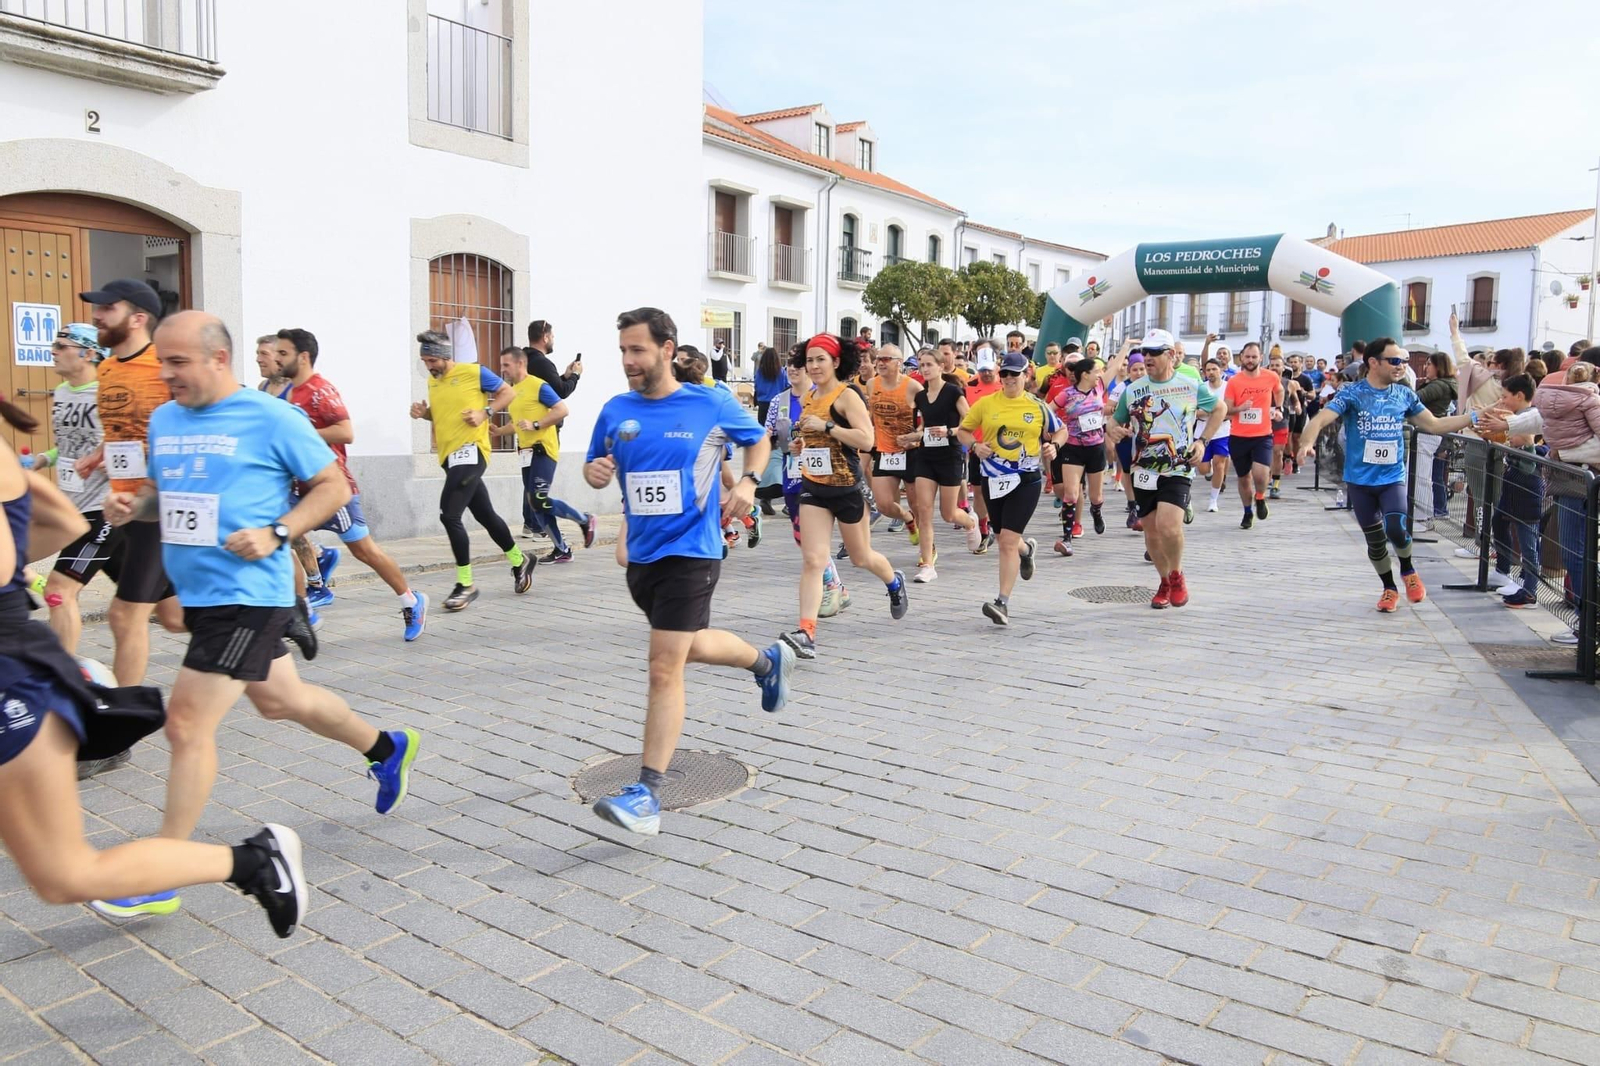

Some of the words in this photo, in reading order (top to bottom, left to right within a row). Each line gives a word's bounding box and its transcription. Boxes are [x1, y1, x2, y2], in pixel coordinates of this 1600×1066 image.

[87, 110, 101, 133] 2
[1145, 252, 1171, 263] LOS
[1175, 247, 1262, 262] PEDROCHES
[1143, 266, 1202, 276] Mancomunidad
[1203, 265, 1213, 274] de
[1215, 263, 1260, 275] Municipios
[17, 346, 53, 362] BAÑO
[62, 402, 98, 429] 26K
[1243, 412, 1258, 420] 150
[1371, 415, 1396, 423] MEDIA
[453, 449, 470, 460] 125
[1374, 448, 1389, 458] 90
[112, 454, 129, 469] 86
[806, 456, 823, 469] 126
[885, 458, 900, 466] 163
[1138, 473, 1150, 483] 69
[998, 480, 1011, 491] 27
[635, 486, 667, 503] 155
[166, 509, 198, 531] 178
